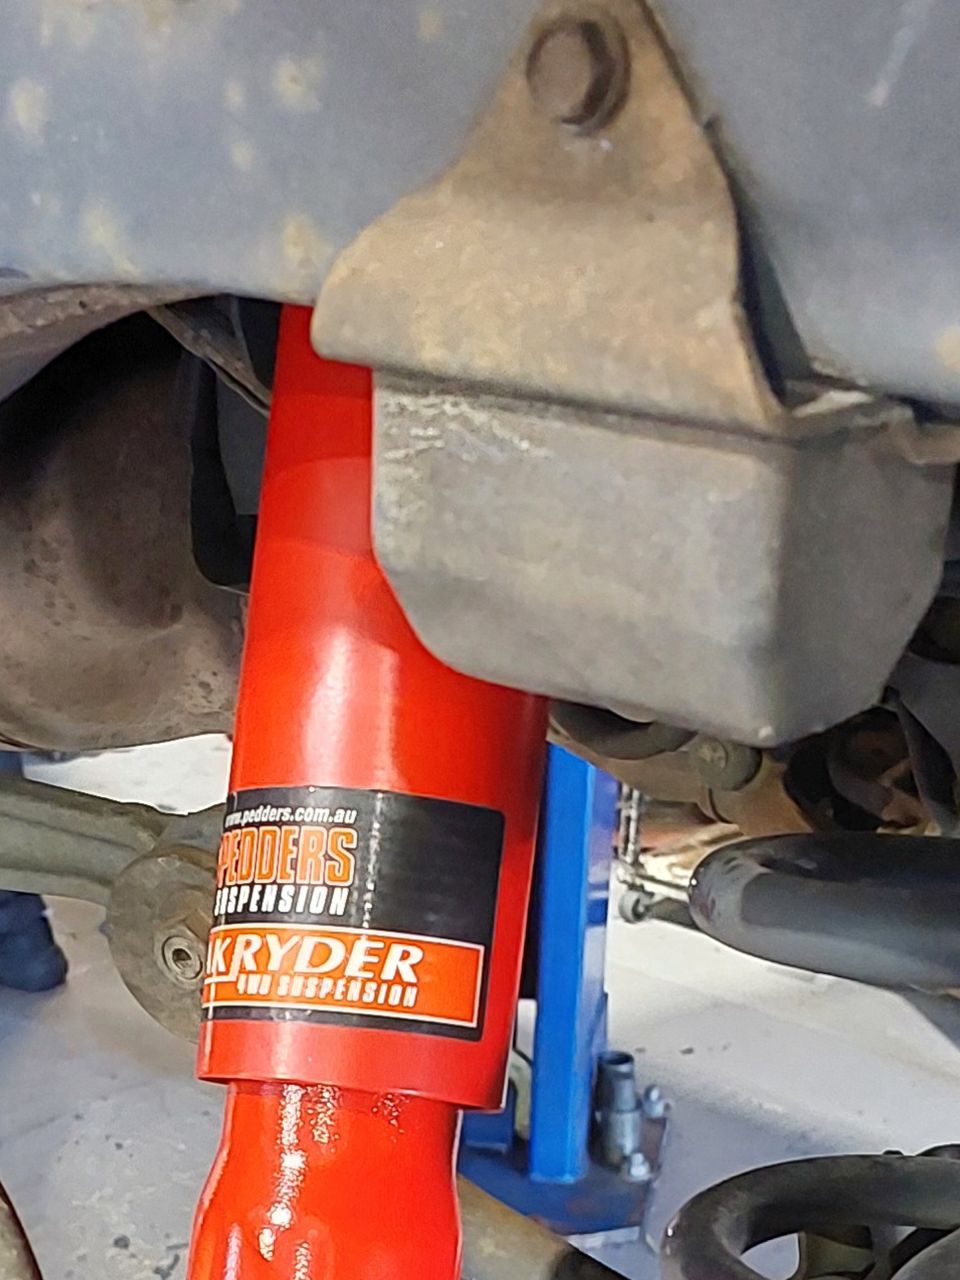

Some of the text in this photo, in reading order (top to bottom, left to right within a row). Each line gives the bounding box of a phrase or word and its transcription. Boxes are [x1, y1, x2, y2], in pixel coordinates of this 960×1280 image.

[217, 825, 358, 888] PEDDERS
[214, 885, 349, 916] SUSPENSION
[237, 973, 418, 1008] 4WD SUSPENSION
